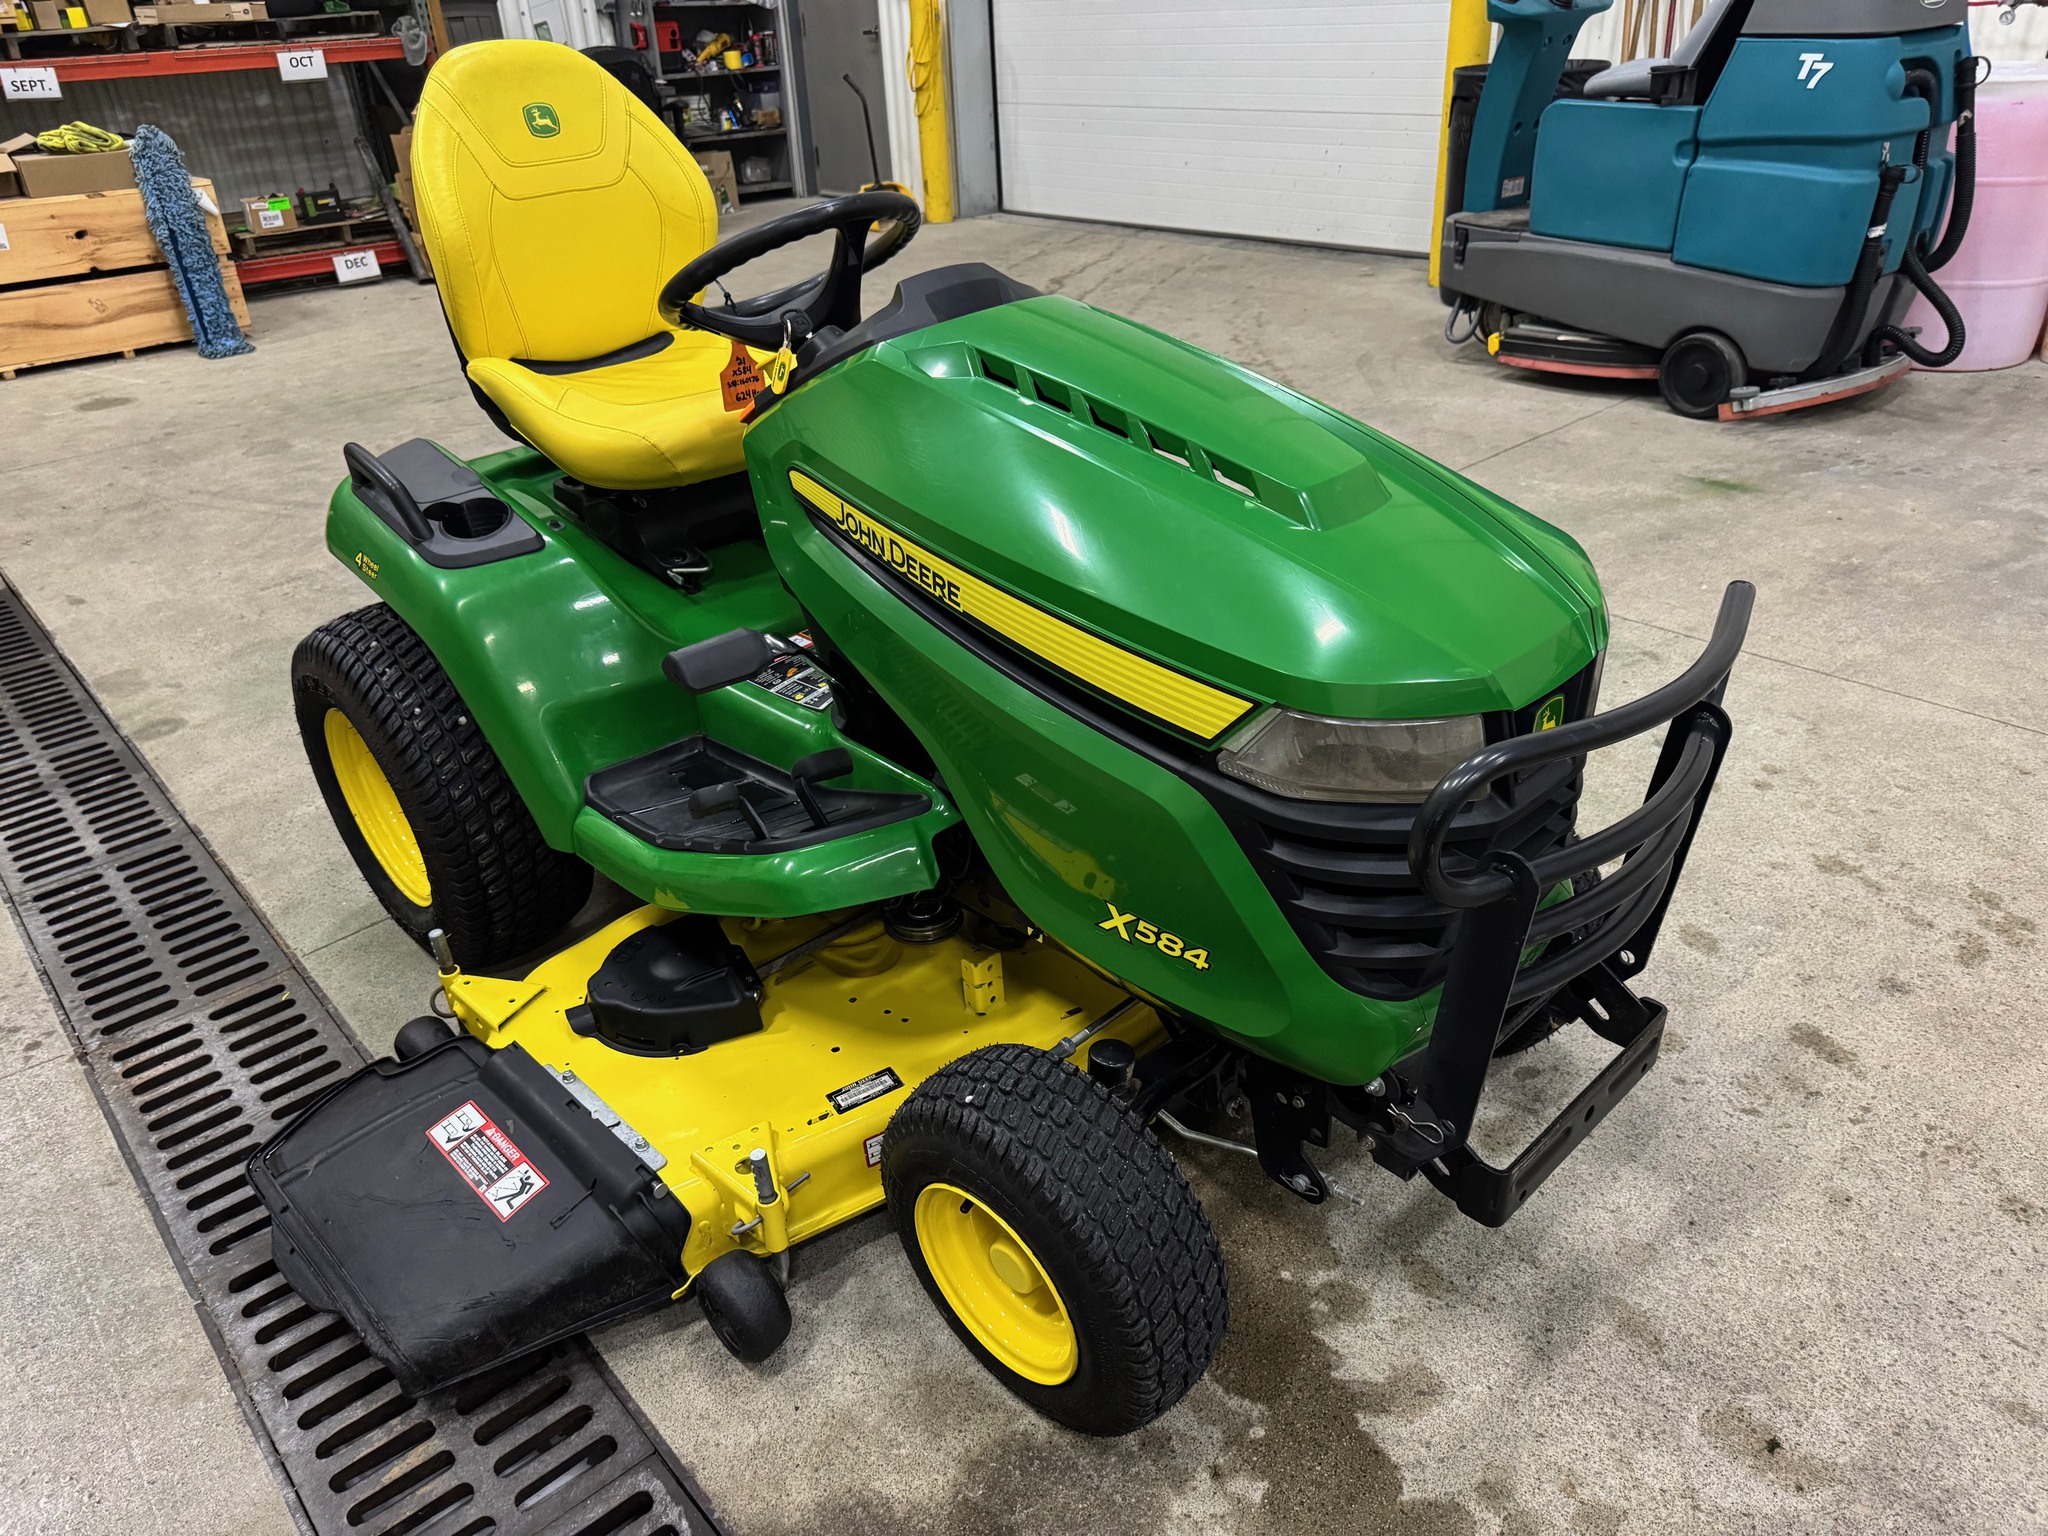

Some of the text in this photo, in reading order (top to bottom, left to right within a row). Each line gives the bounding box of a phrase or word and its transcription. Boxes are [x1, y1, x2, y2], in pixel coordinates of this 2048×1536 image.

[289, 56, 314, 68] OCT
[1797, 53, 1834, 89] T7
[11, 80, 52, 92] SEPT.
[344, 256, 369, 270] DEC
[355, 552, 363, 567] 4
[835, 502, 963, 613] JOHN DEERE
[1098, 902, 1210, 970] X584
[492, 1132, 521, 1161] DANGER
